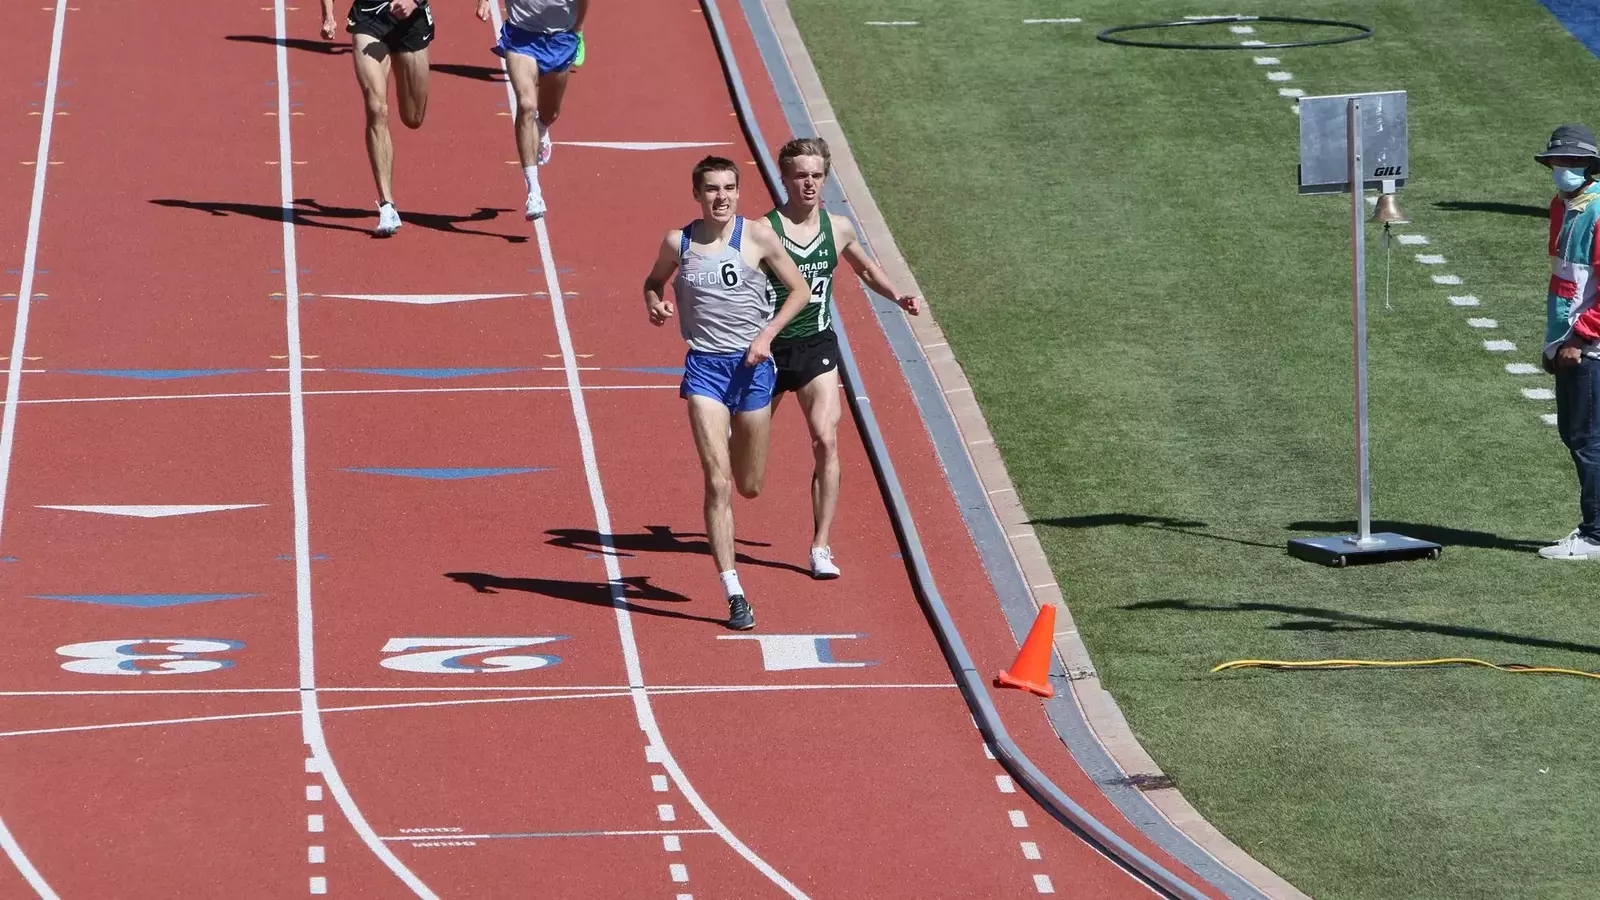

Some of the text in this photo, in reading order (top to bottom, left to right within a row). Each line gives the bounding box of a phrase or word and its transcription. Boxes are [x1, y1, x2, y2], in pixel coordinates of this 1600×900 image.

[1374, 166, 1402, 176] GILL
[721, 263, 738, 287] 6
[798, 260, 828, 272] ORADO
[801, 270, 818, 278] ATE
[811, 280, 824, 298] 4
[55, 637, 247, 675] 3
[380, 634, 572, 674] 2
[717, 633, 880, 671] 1
